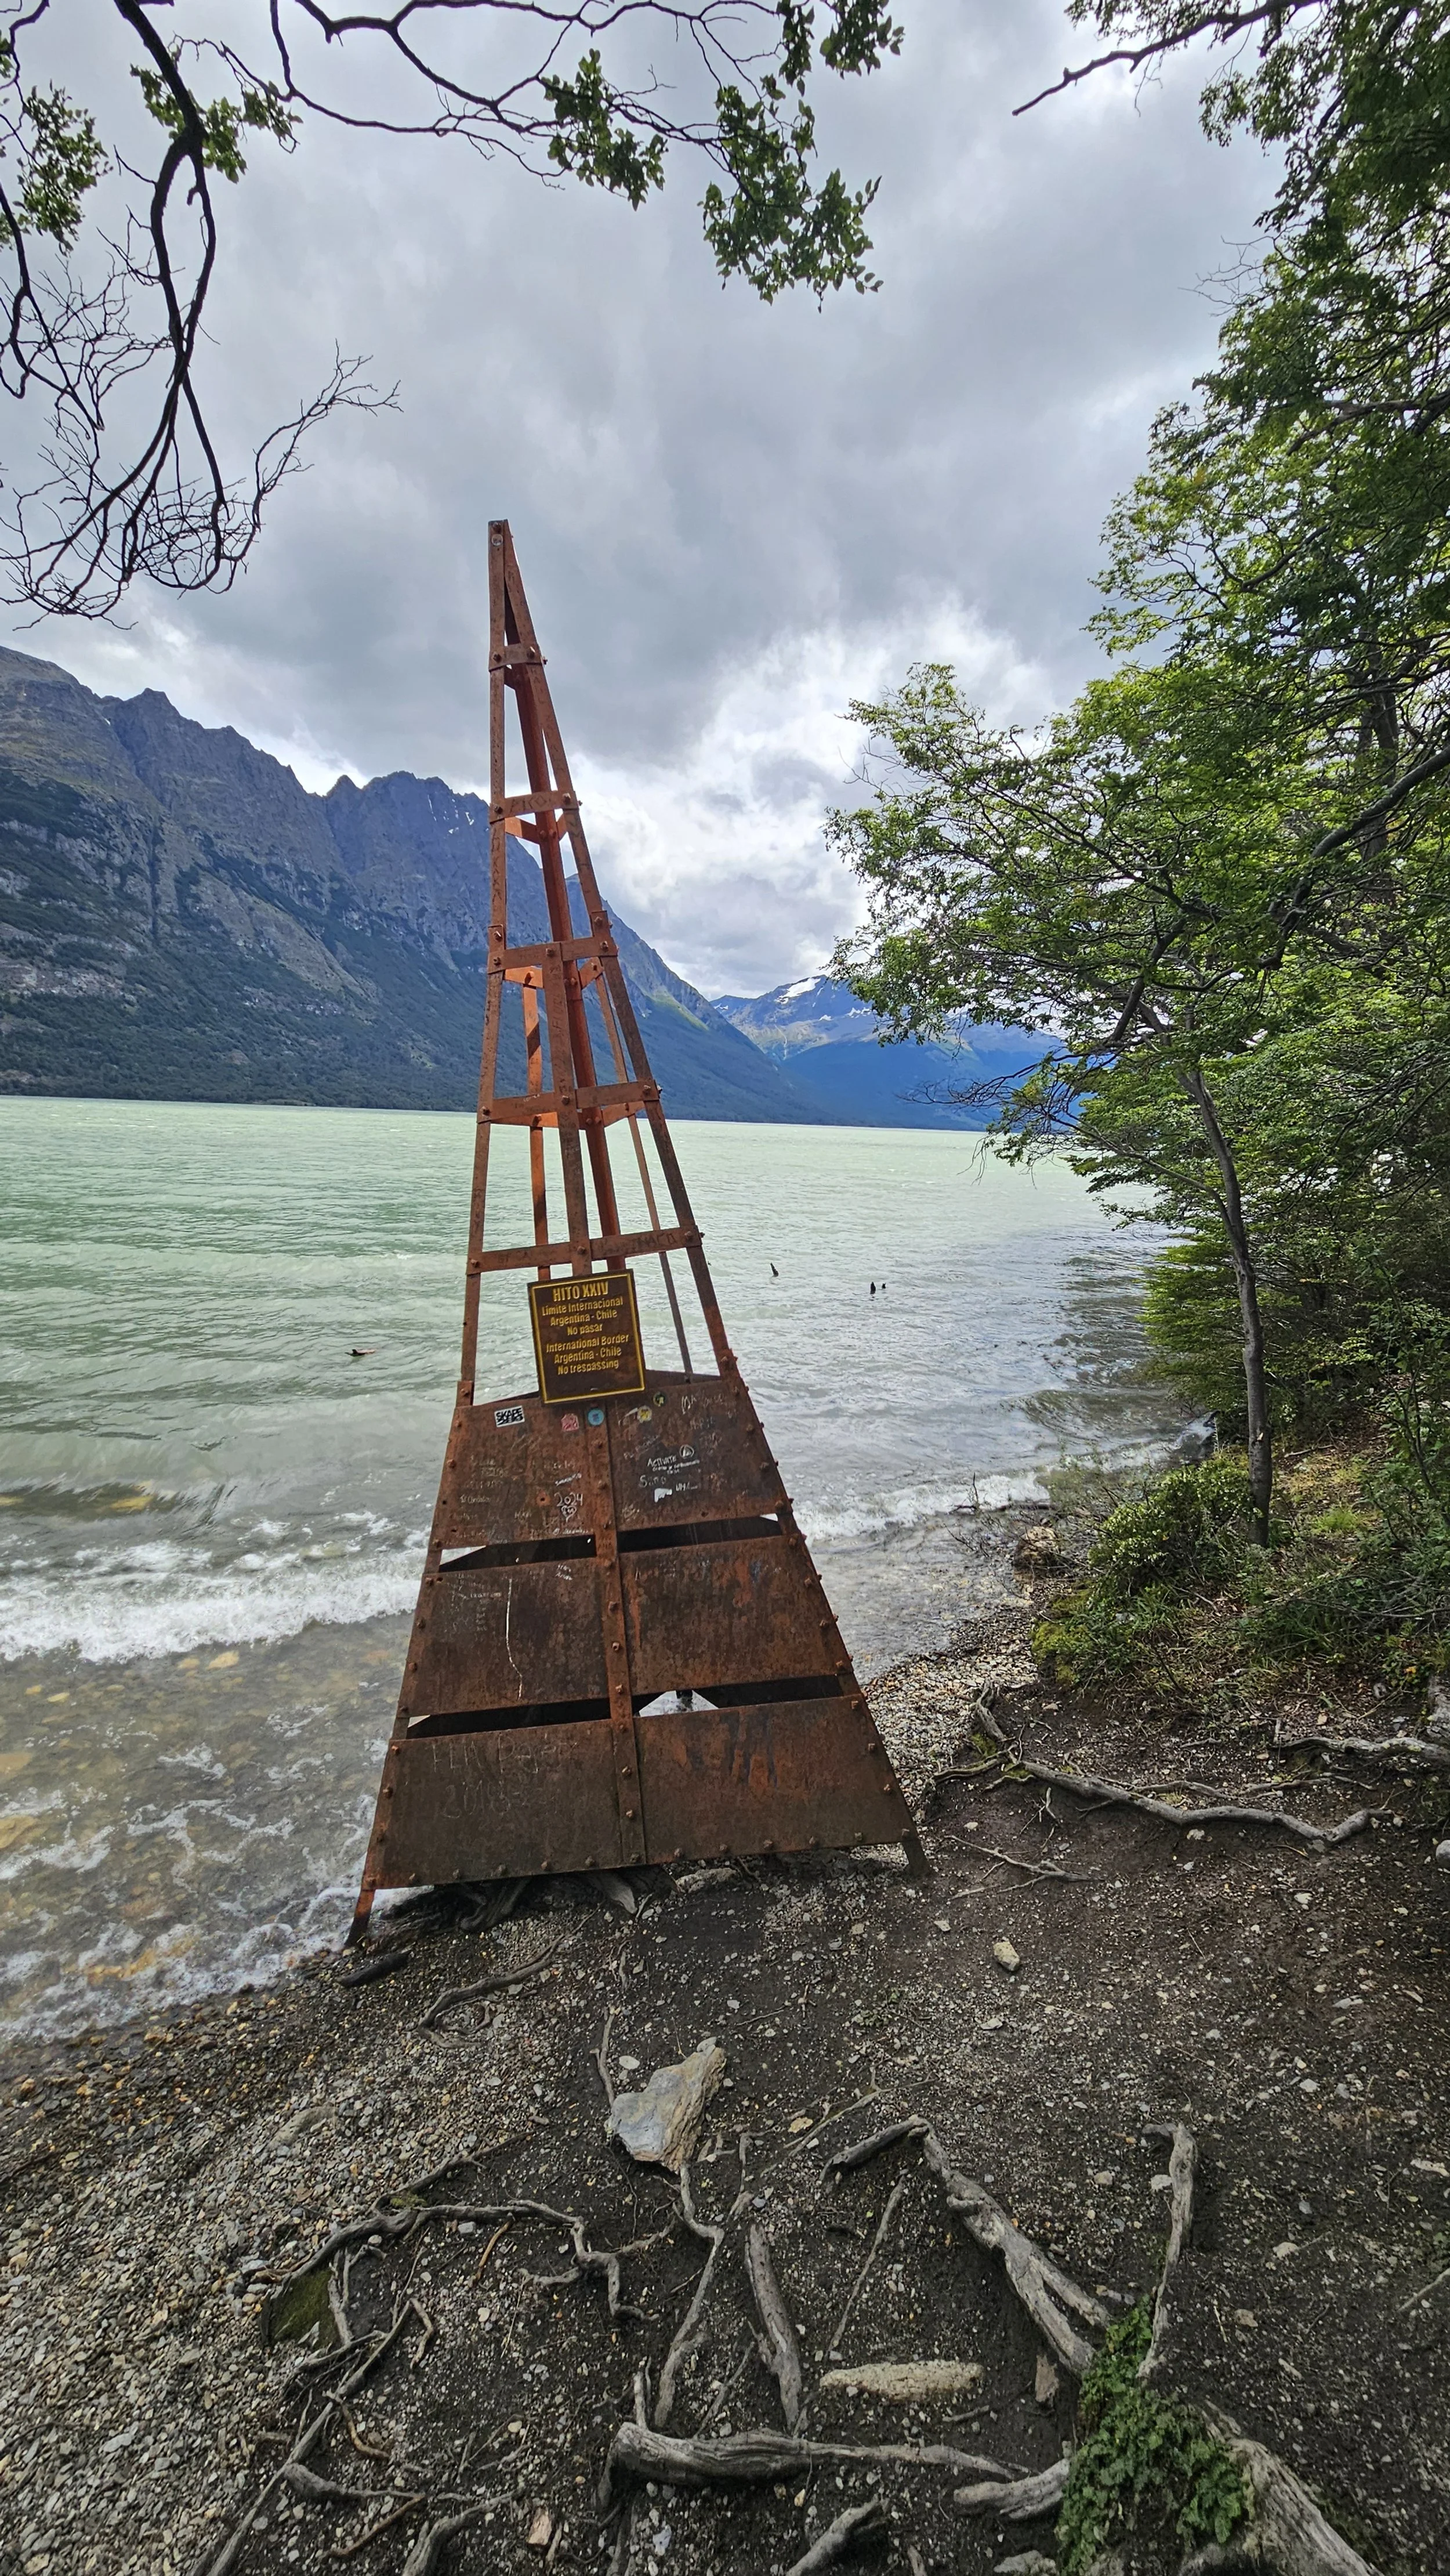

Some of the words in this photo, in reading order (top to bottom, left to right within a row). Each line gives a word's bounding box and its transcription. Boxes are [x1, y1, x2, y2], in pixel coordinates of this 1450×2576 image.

[553, 1285, 579, 1302] HITO
[583, 1281, 608, 1297] XXIV
[568, 1296, 623, 1312] Internacional
[550, 1312, 590, 1327] Argentina
[596, 1309, 618, 1319] Chile
[567, 1326, 578, 1336] No
[580, 1323, 603, 1336] pasar
[546, 1337, 600, 1353] International
[601, 1334, 629, 1345] Border
[554, 1349, 594, 1364] Argentina
[600, 1346, 622, 1358] Chile
[558, 1365, 568, 1376] No
[570, 1359, 619, 1374] trespassing
[554, 1492, 583, 1507] 2024
